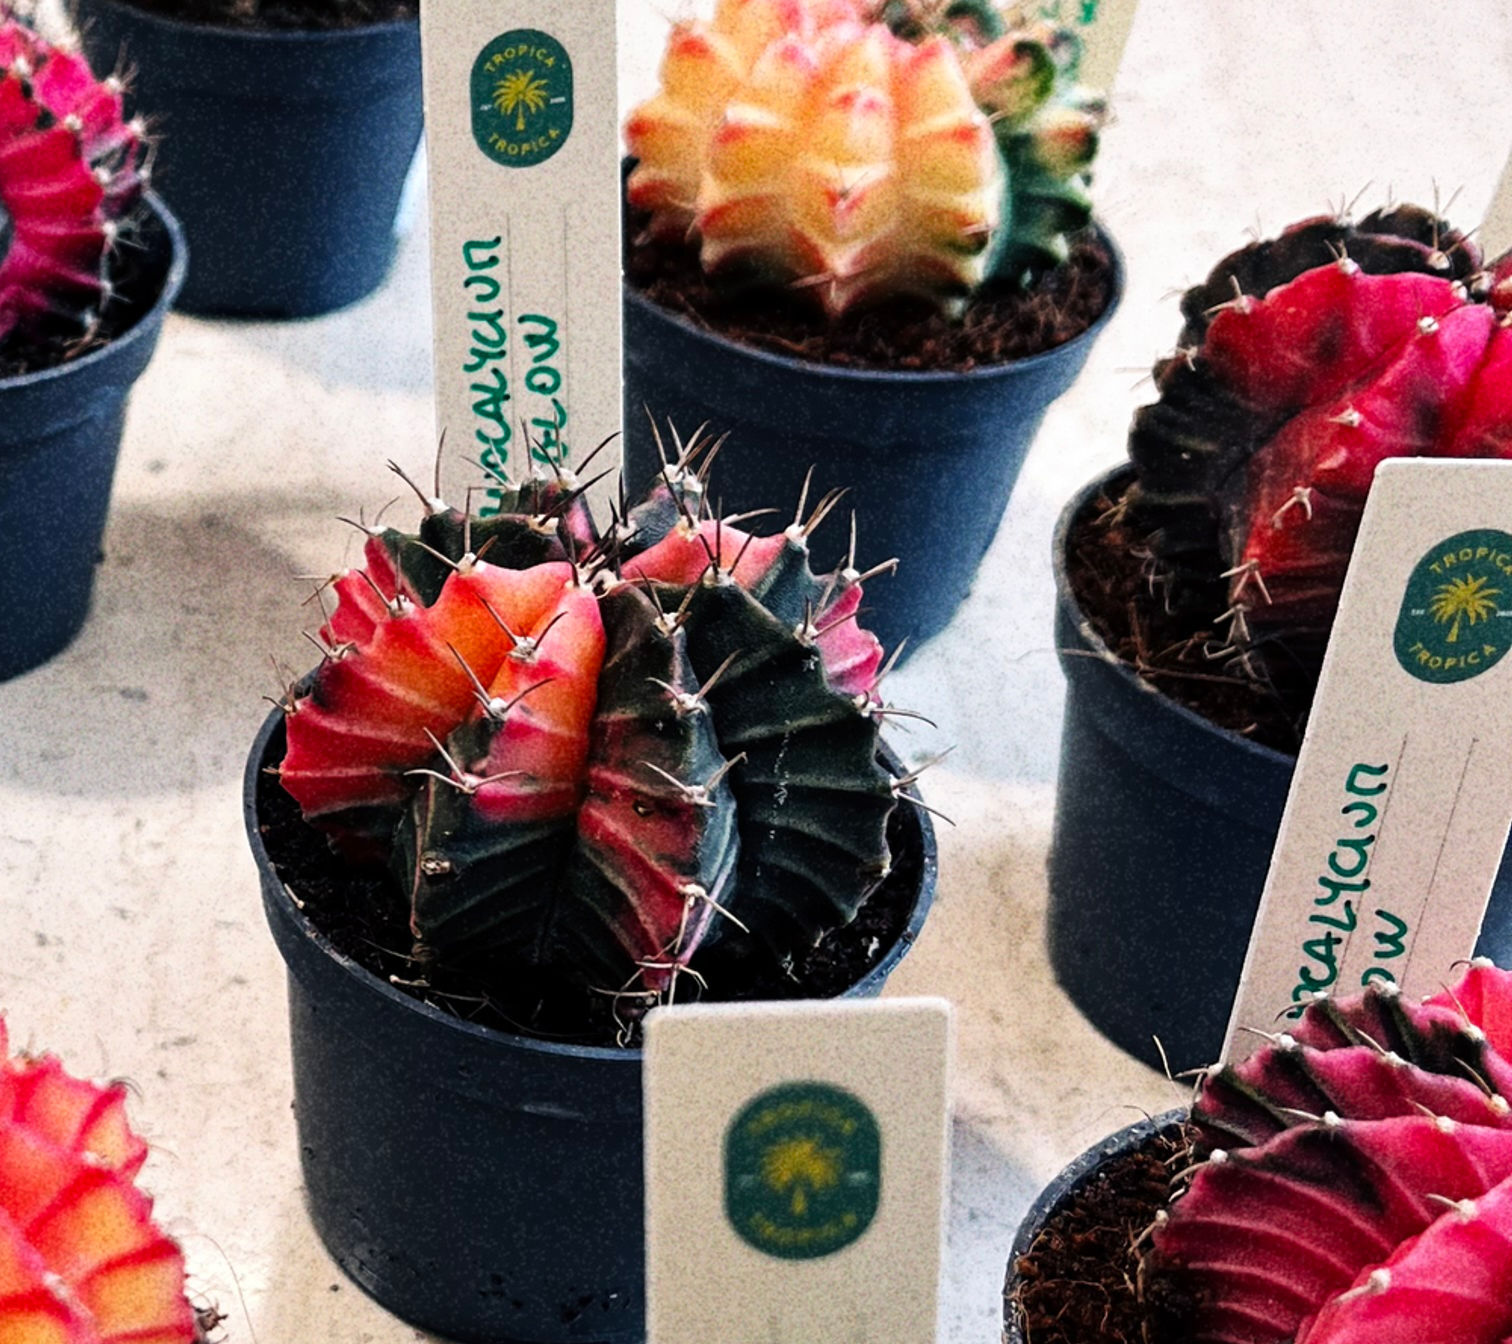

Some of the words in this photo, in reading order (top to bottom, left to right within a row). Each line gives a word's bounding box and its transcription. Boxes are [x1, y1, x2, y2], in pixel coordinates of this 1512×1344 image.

[483, 44, 556, 72] TROPICA
[488, 129, 560, 156] TROPICA
[1408, 641, 1497, 670] TROPICA
